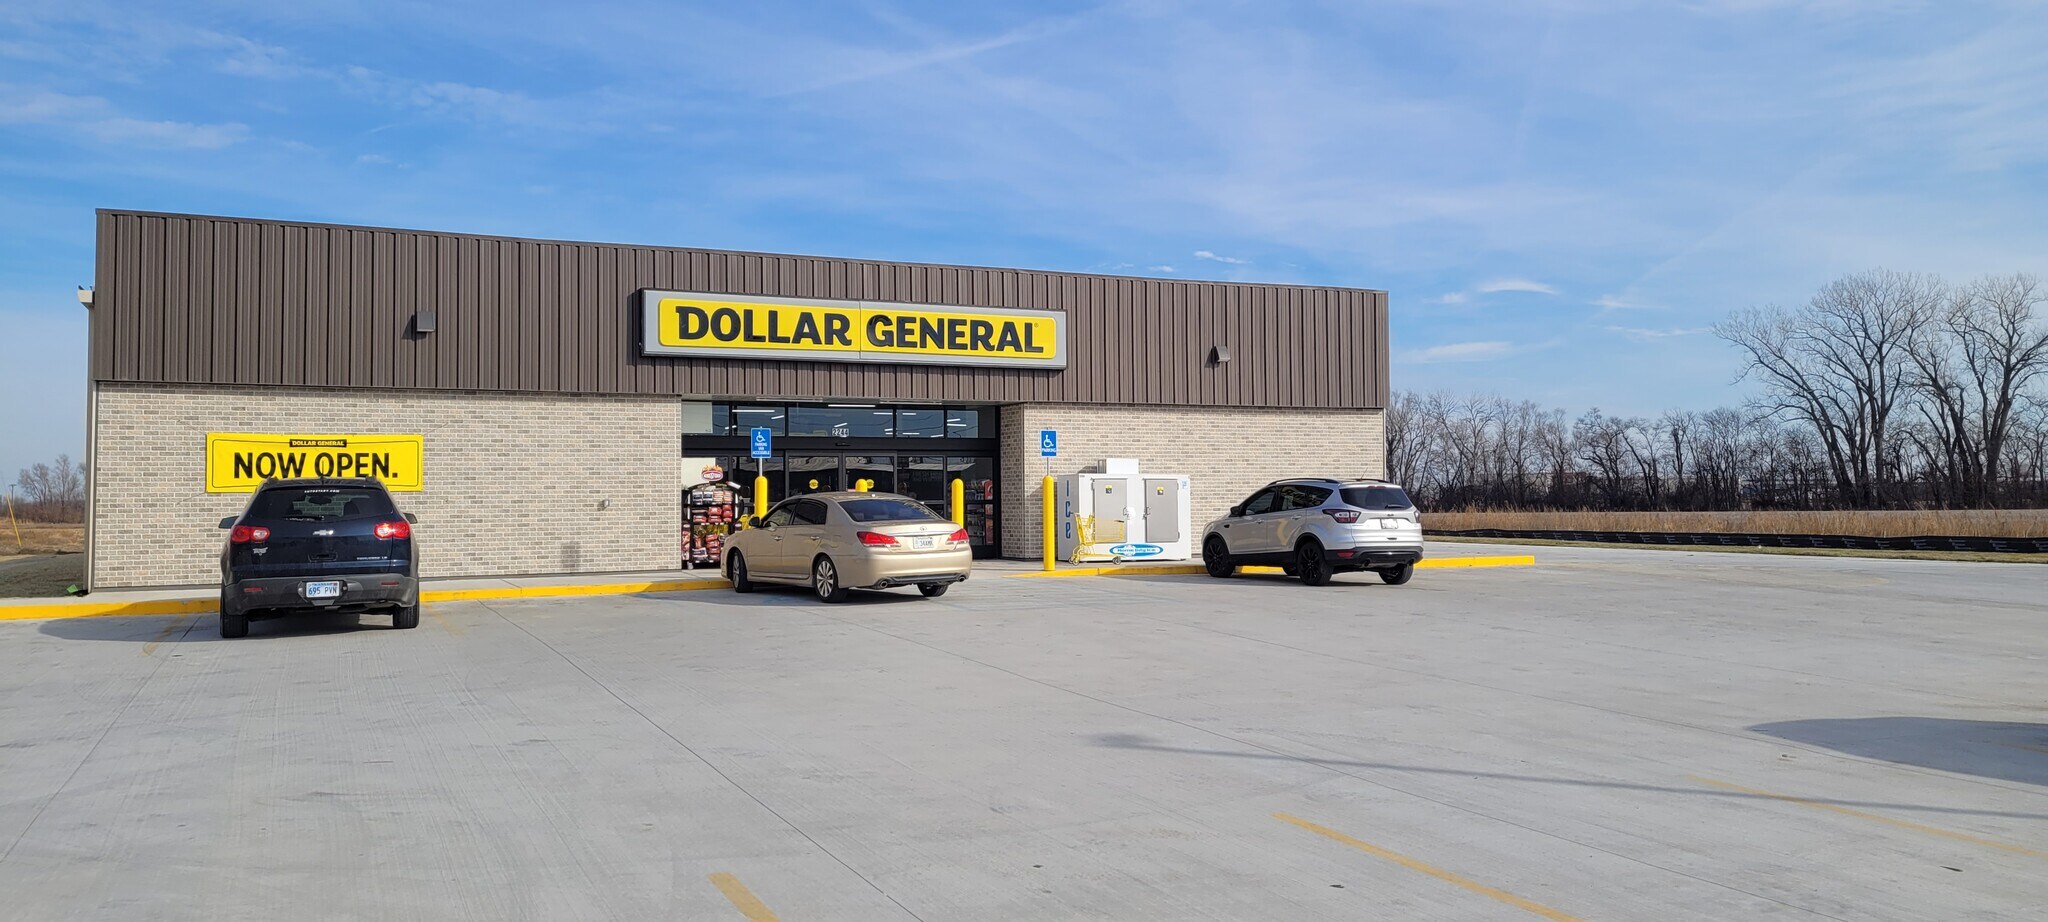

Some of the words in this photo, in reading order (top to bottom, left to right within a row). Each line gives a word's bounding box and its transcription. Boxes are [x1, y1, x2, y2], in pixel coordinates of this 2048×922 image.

[675, 305, 852, 347] DOLLAR
[866, 314, 1044, 353] GENERAL
[832, 428, 849, 437] 2244
[233, 452, 307, 479] NOW
[314, 452, 399, 479] OPEN.
[308, 586, 321, 595] 695
[324, 586, 338, 595] PVN
